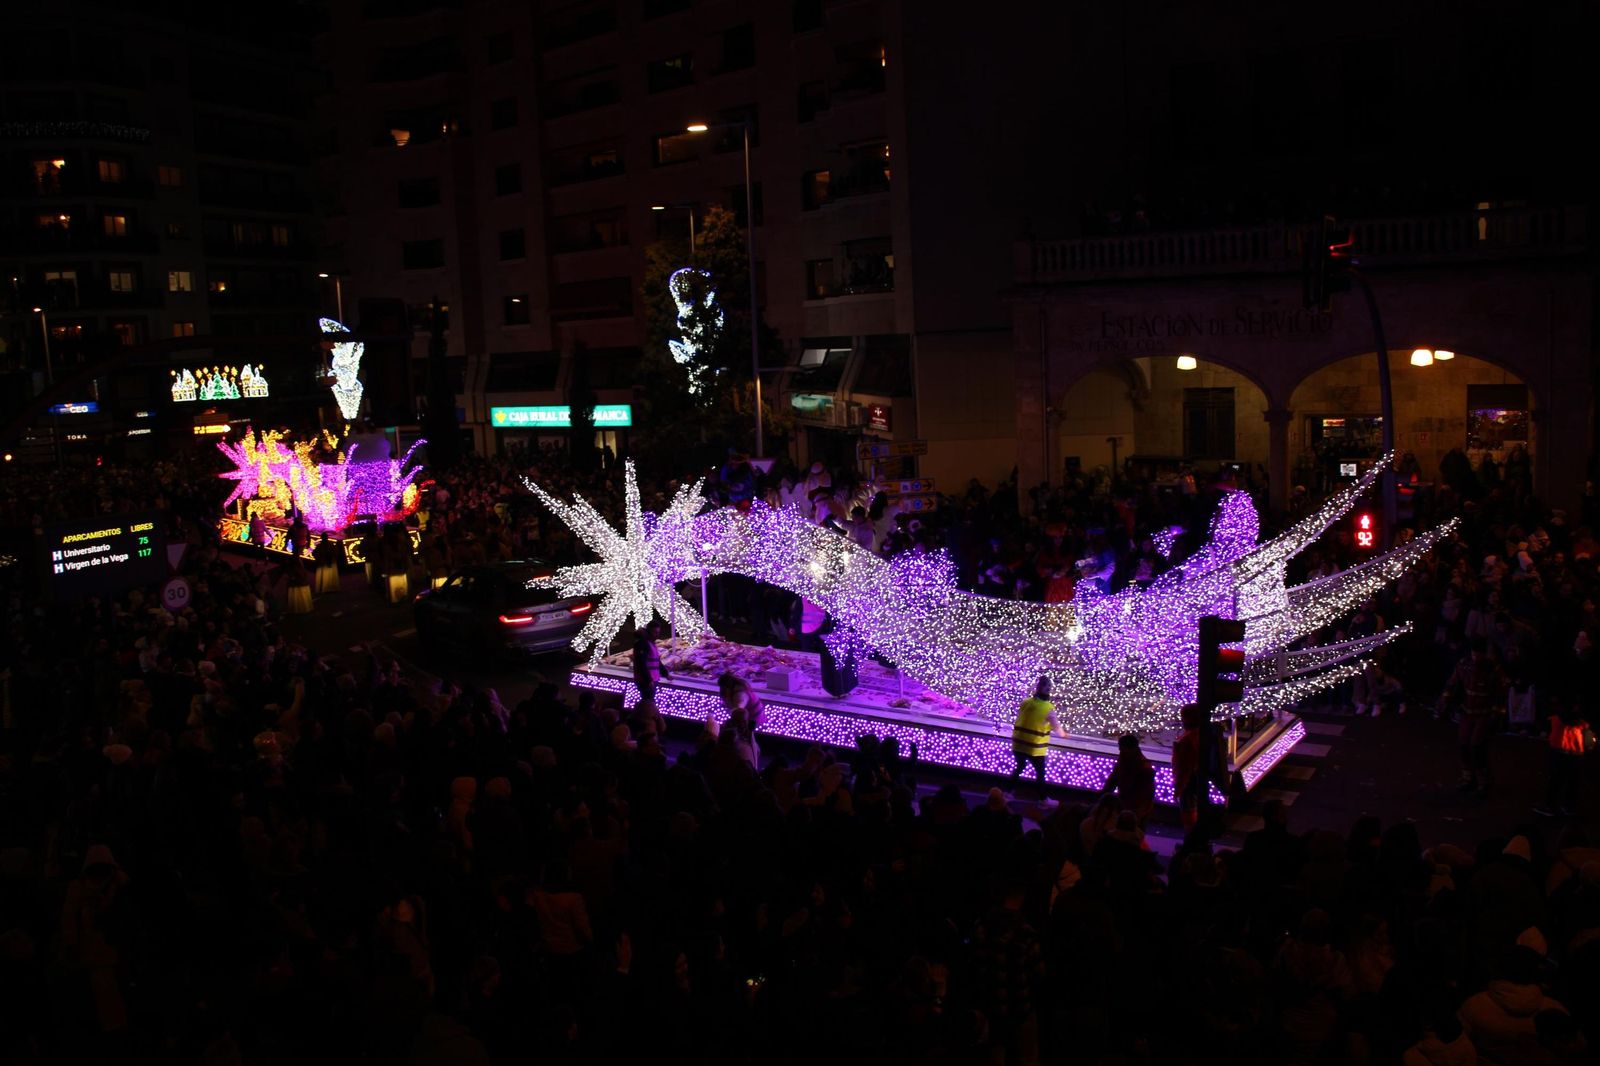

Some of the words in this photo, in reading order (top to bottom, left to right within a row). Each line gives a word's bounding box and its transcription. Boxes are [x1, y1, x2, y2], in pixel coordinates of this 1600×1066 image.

[1209, 319, 1229, 336] DE
[1234, 305, 1333, 339] SERVICIO
[509, 411, 529, 424] CAJA
[63, 528, 121, 543] APARCAMIENTOS
[130, 523, 153, 532] LIBRES
[64, 543, 111, 558] Universitario
[138, 536, 149, 545] 75
[65, 557, 90, 570] Virgen
[91, 558, 101, 566] de
[101, 556, 110, 564] la
[110, 553, 129, 563] Vega
[138, 548, 152, 558] 117
[168, 587, 186, 600] 30
